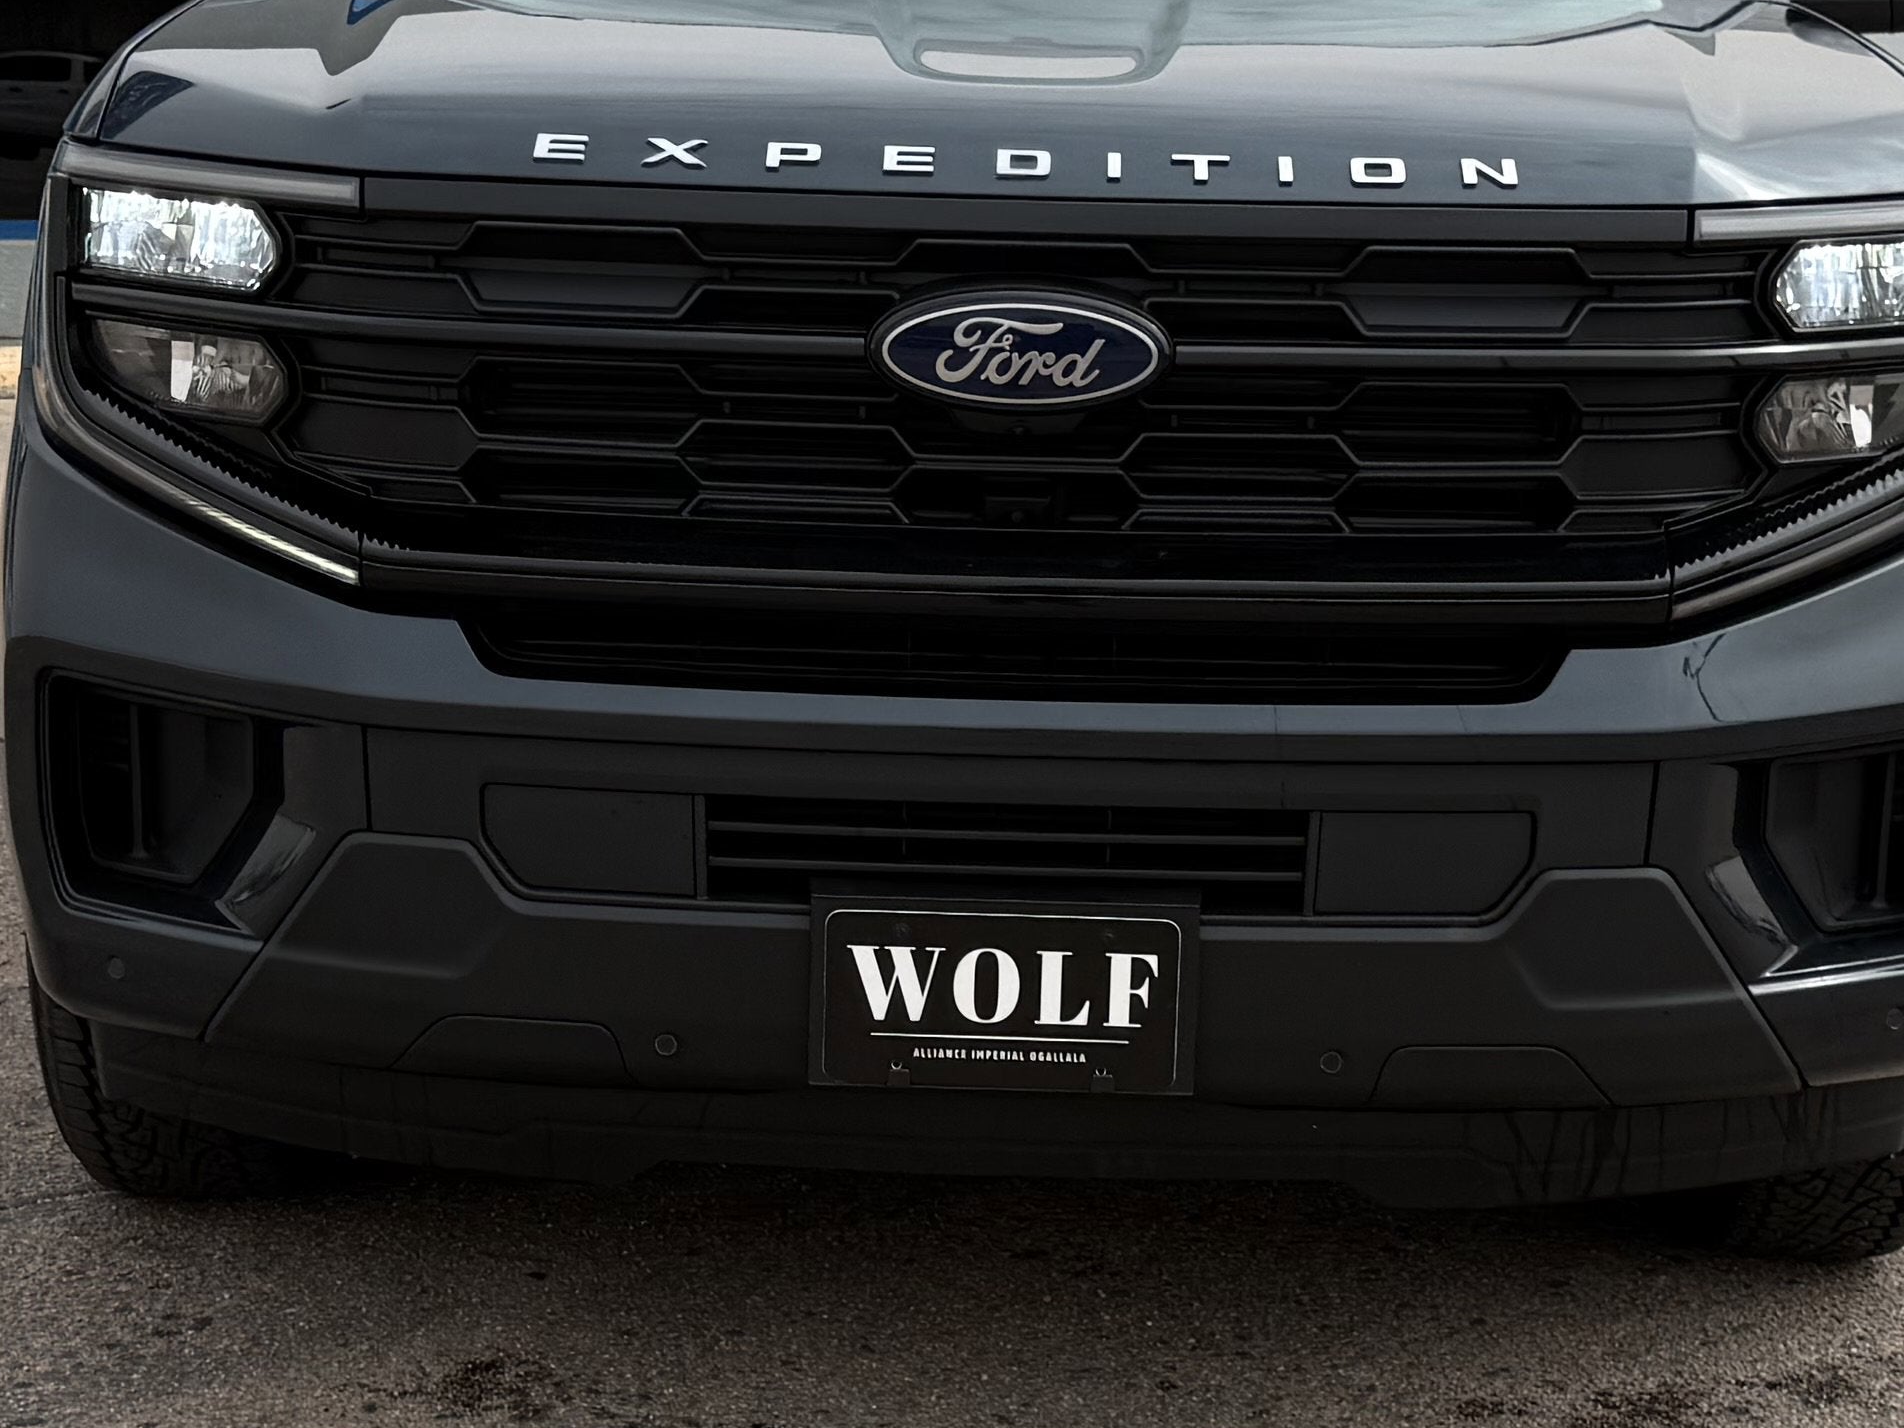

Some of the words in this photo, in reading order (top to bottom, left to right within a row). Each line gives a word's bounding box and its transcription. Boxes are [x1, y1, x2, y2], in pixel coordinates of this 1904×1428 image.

[532, 132, 1519, 188] EXPEDITION
[935, 316, 1106, 388] Ford
[846, 944, 1159, 1028] WOLF
[971, 1049, 1025, 1062] IMPERIAL
[1029, 1051, 1087, 1063] OGALLALA
